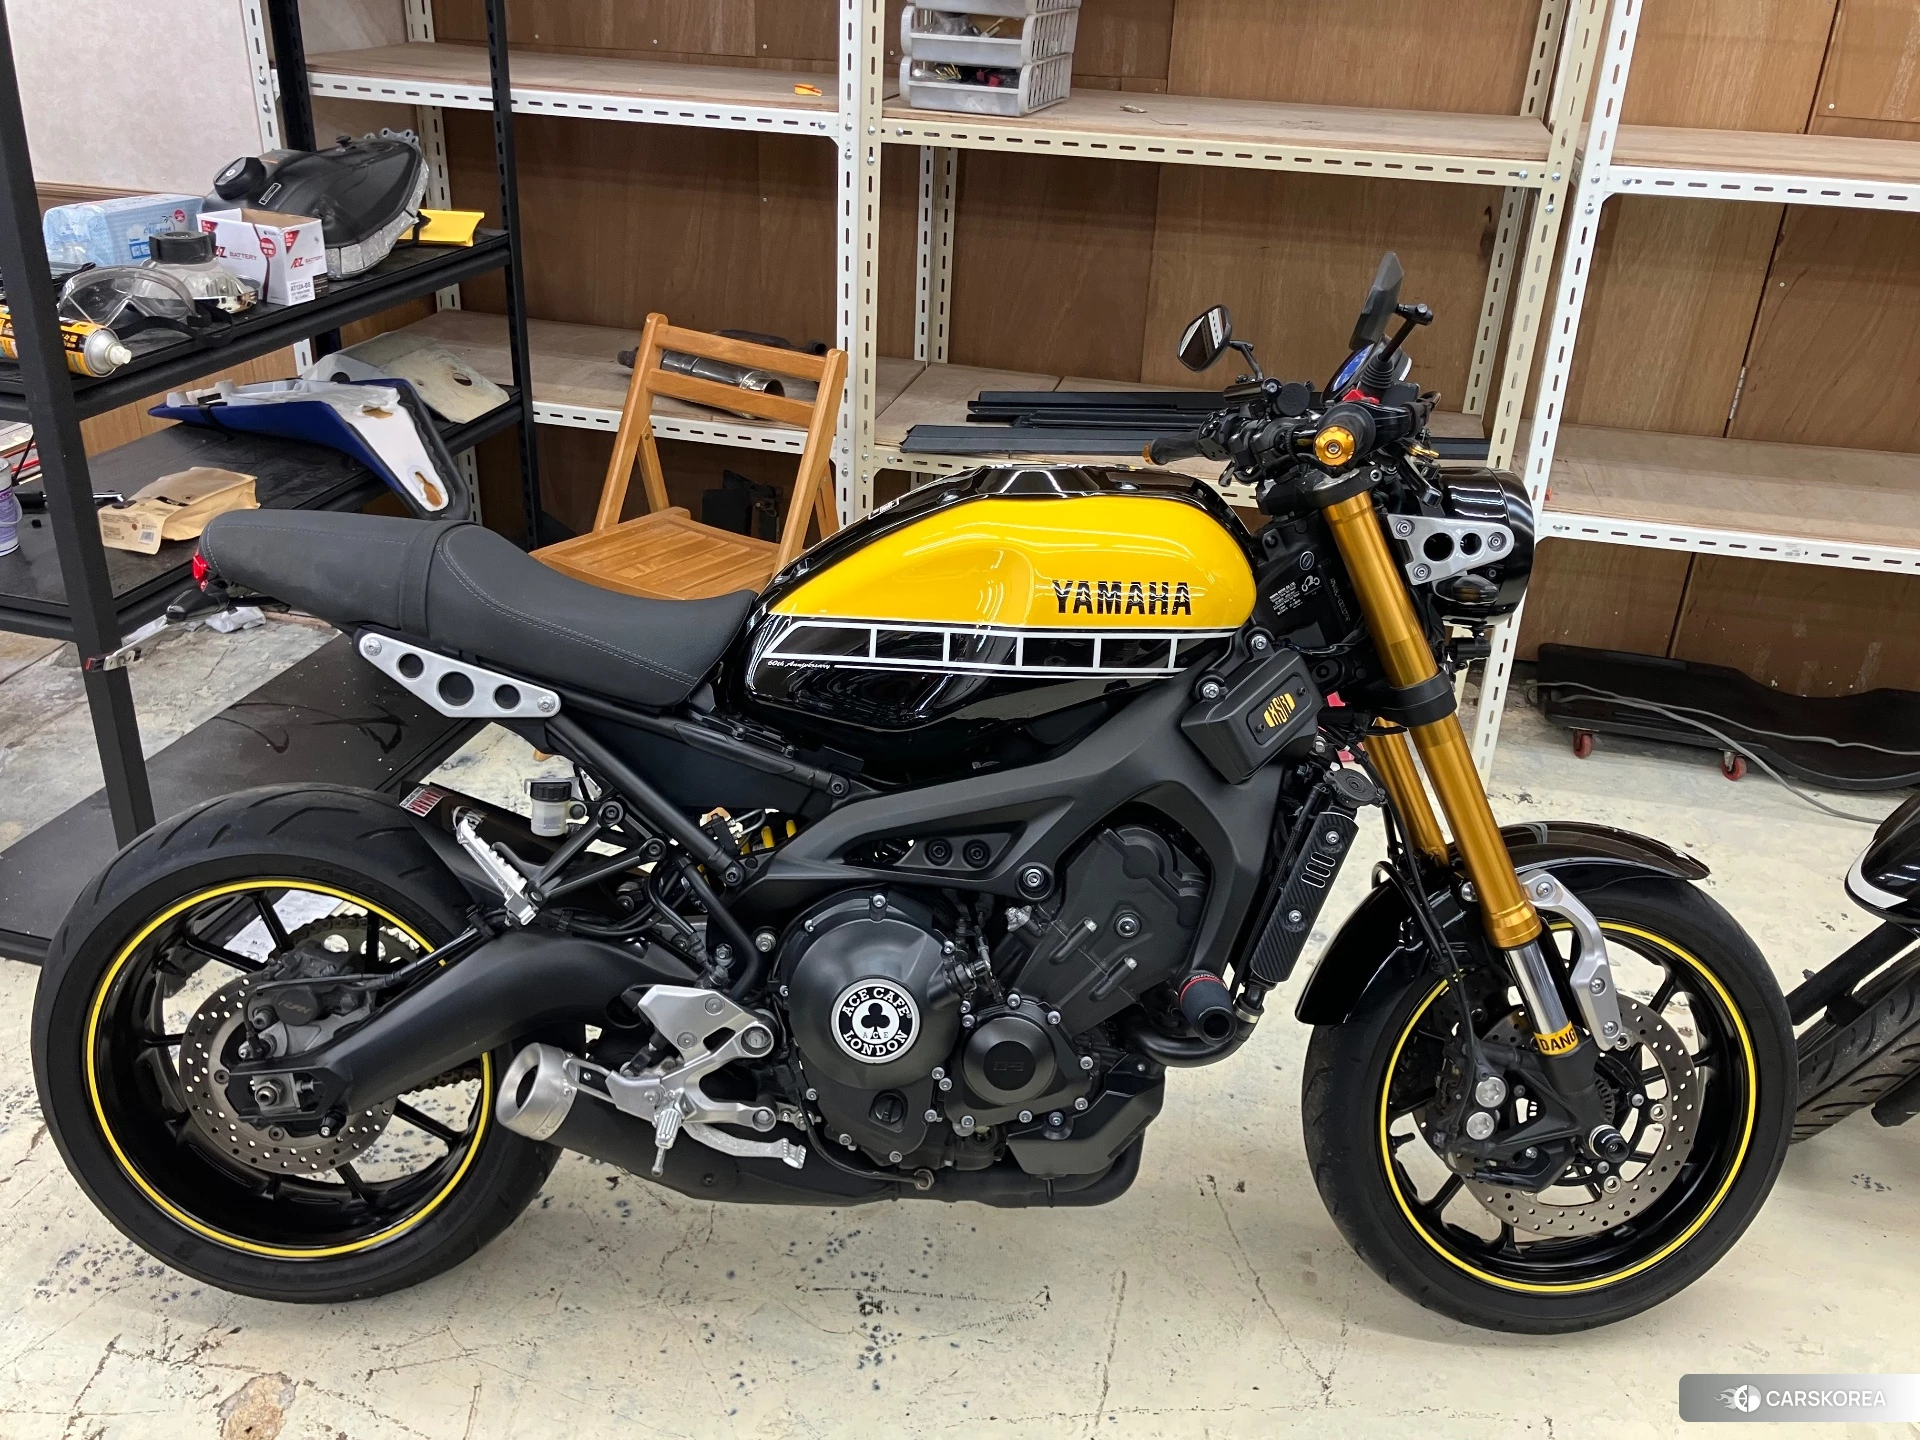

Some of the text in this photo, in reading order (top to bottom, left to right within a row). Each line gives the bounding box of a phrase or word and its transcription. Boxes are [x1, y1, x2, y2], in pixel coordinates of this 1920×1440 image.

[230, 251, 257, 260] BATTERY
[1052, 580, 1192, 616] YAMAHA
[1267, 695, 1292, 726] XSR
[842, 987, 910, 1018] ACE CAFE
[843, 1029, 908, 1056] LONDON
